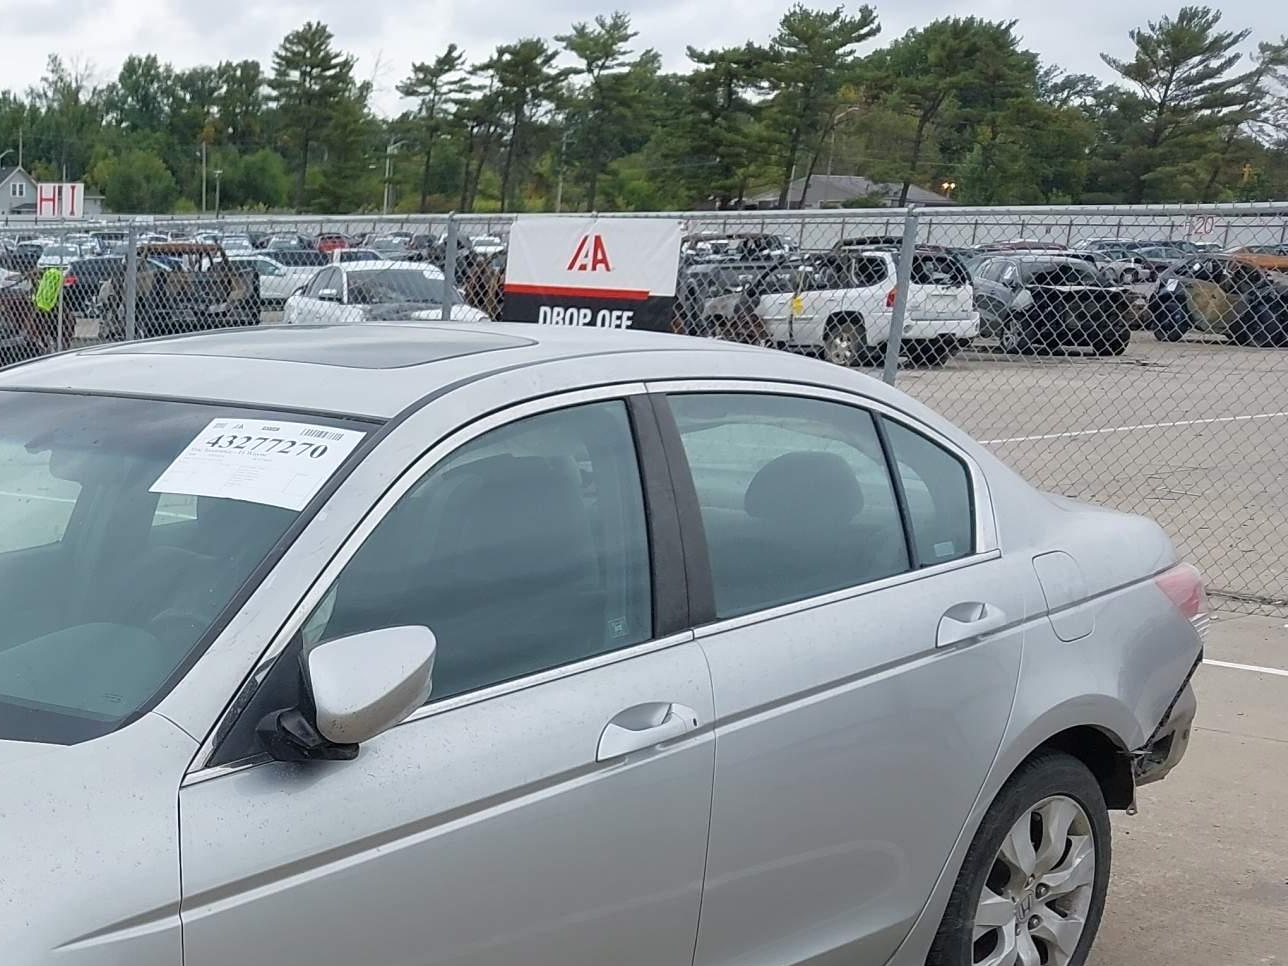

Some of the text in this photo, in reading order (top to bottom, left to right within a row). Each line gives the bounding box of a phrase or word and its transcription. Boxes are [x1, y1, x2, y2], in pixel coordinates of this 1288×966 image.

[39, 185, 77, 217] HI
[538, 305, 634, 329] DROP OFF
[206, 434, 328, 459] 43277270
